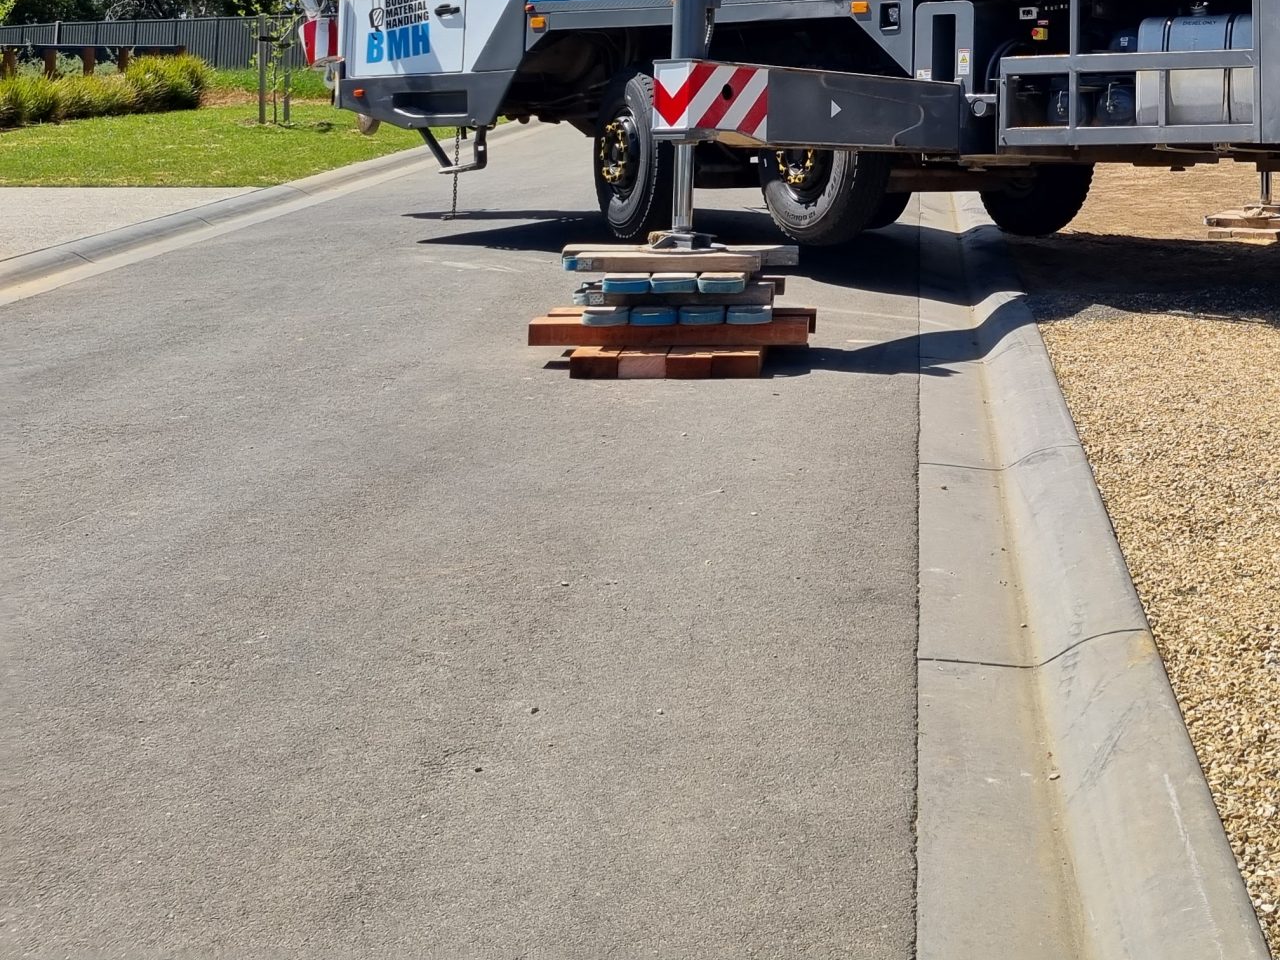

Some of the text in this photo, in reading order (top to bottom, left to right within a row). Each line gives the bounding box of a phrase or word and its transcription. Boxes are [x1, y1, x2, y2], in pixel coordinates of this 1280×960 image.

[385, 0, 428, 19] MATERIAL
[386, 11, 429, 30] HANDLING
[366, 22, 431, 64] BMH
